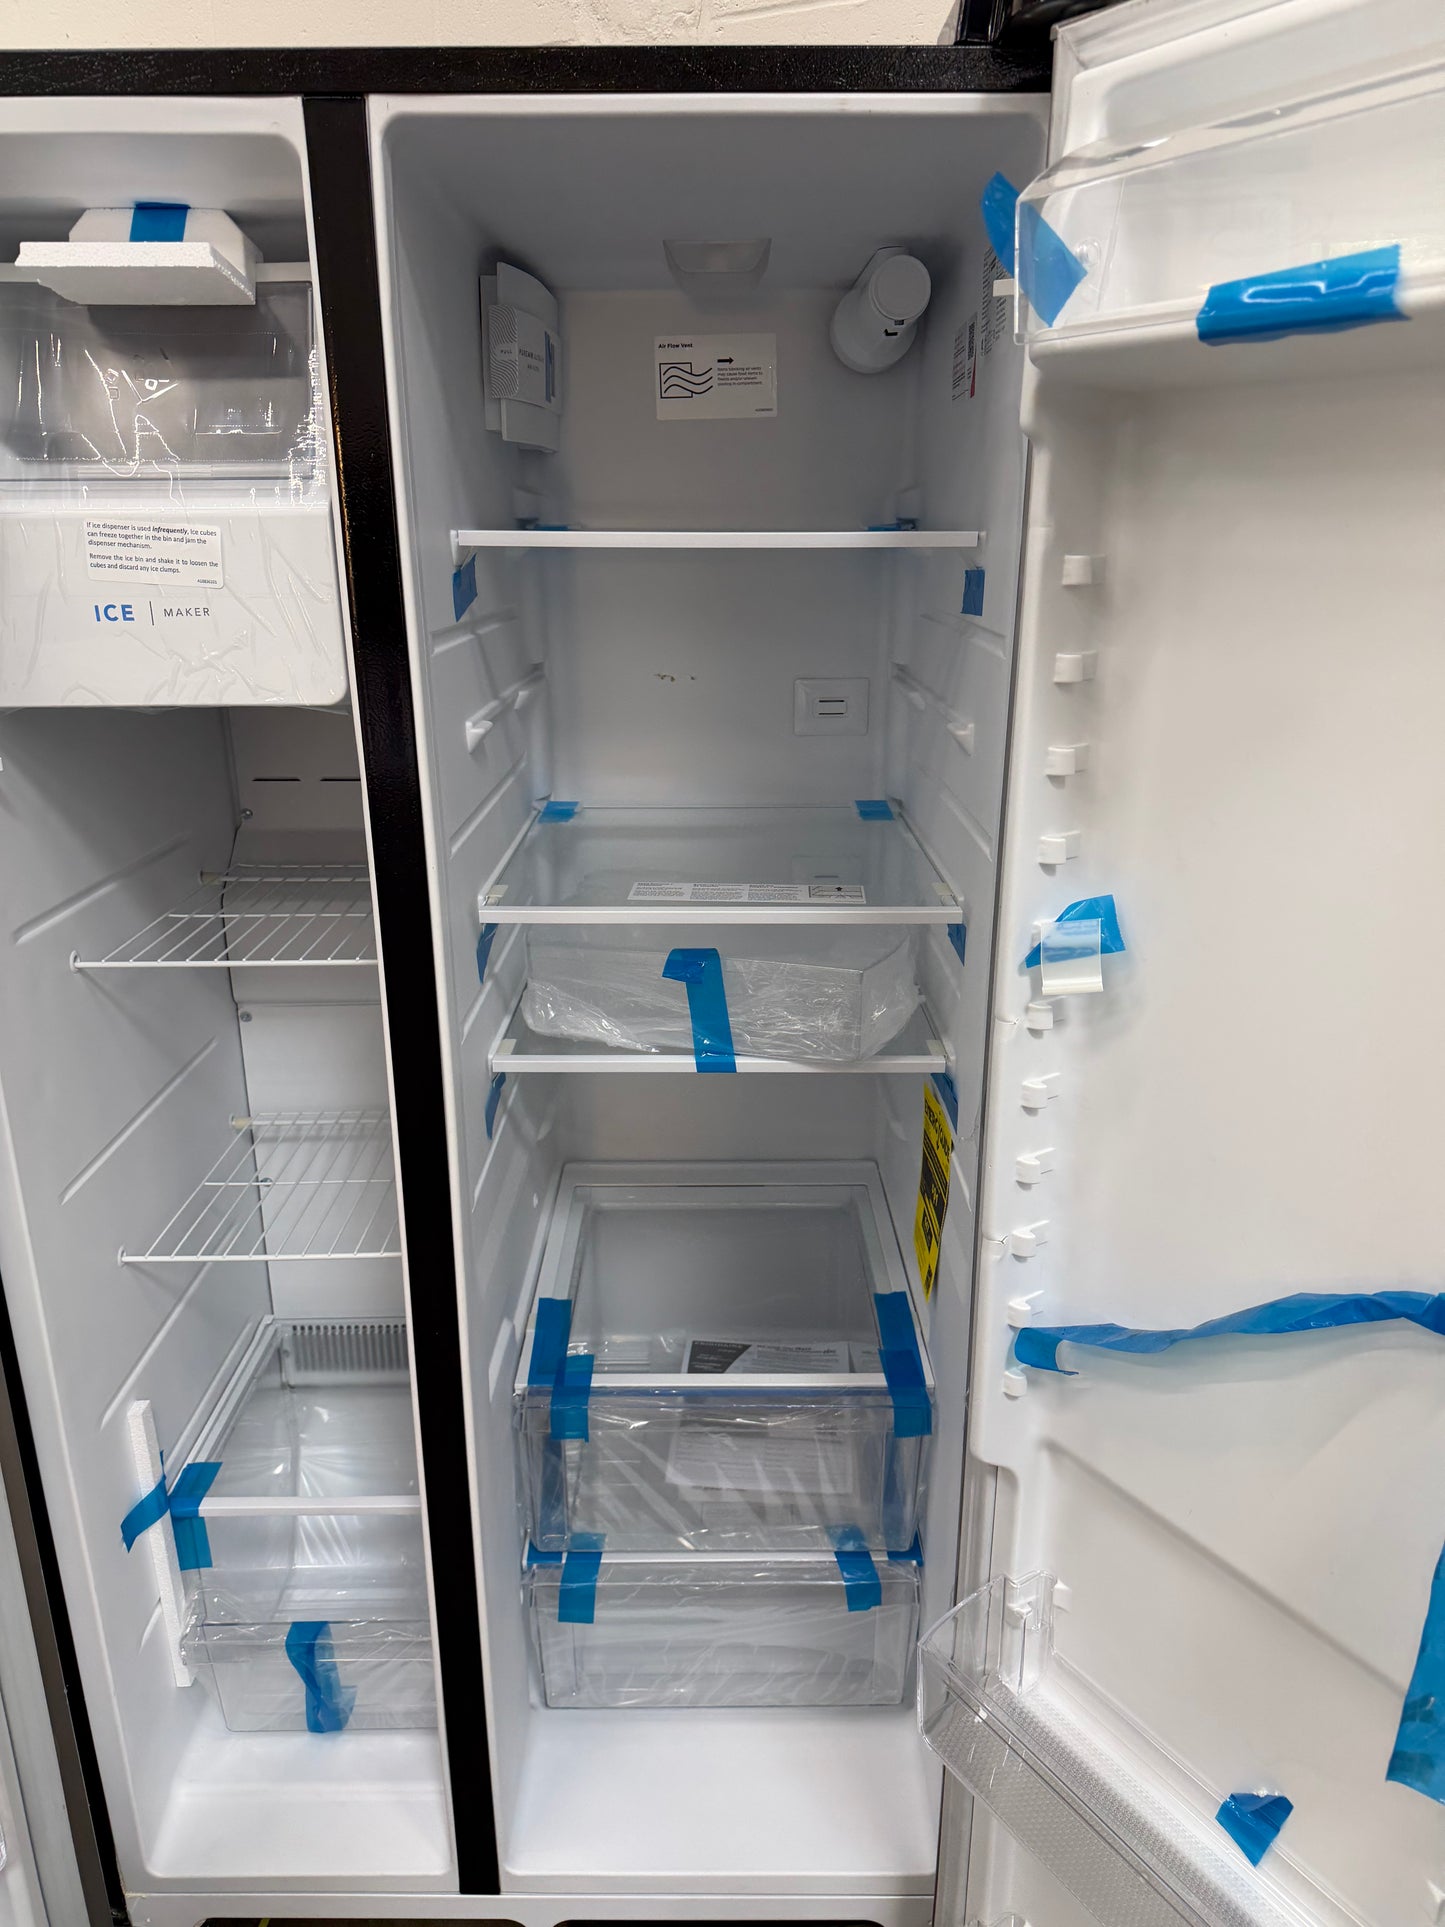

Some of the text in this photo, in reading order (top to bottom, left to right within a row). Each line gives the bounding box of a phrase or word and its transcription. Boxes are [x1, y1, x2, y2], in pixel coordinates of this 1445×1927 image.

[102, 522, 130, 531] dispenser
[152, 526, 189, 535] infrequently,
[99, 530, 117, 538] freeze
[118, 532, 143, 540] together
[88, 539, 152, 549] dispenser mechanism.
[189, 559, 208, 567] loosen
[118, 563, 139, 571] discard
[159, 566, 181, 574] clumps.
[94, 604, 211, 622] ICE MAKER
